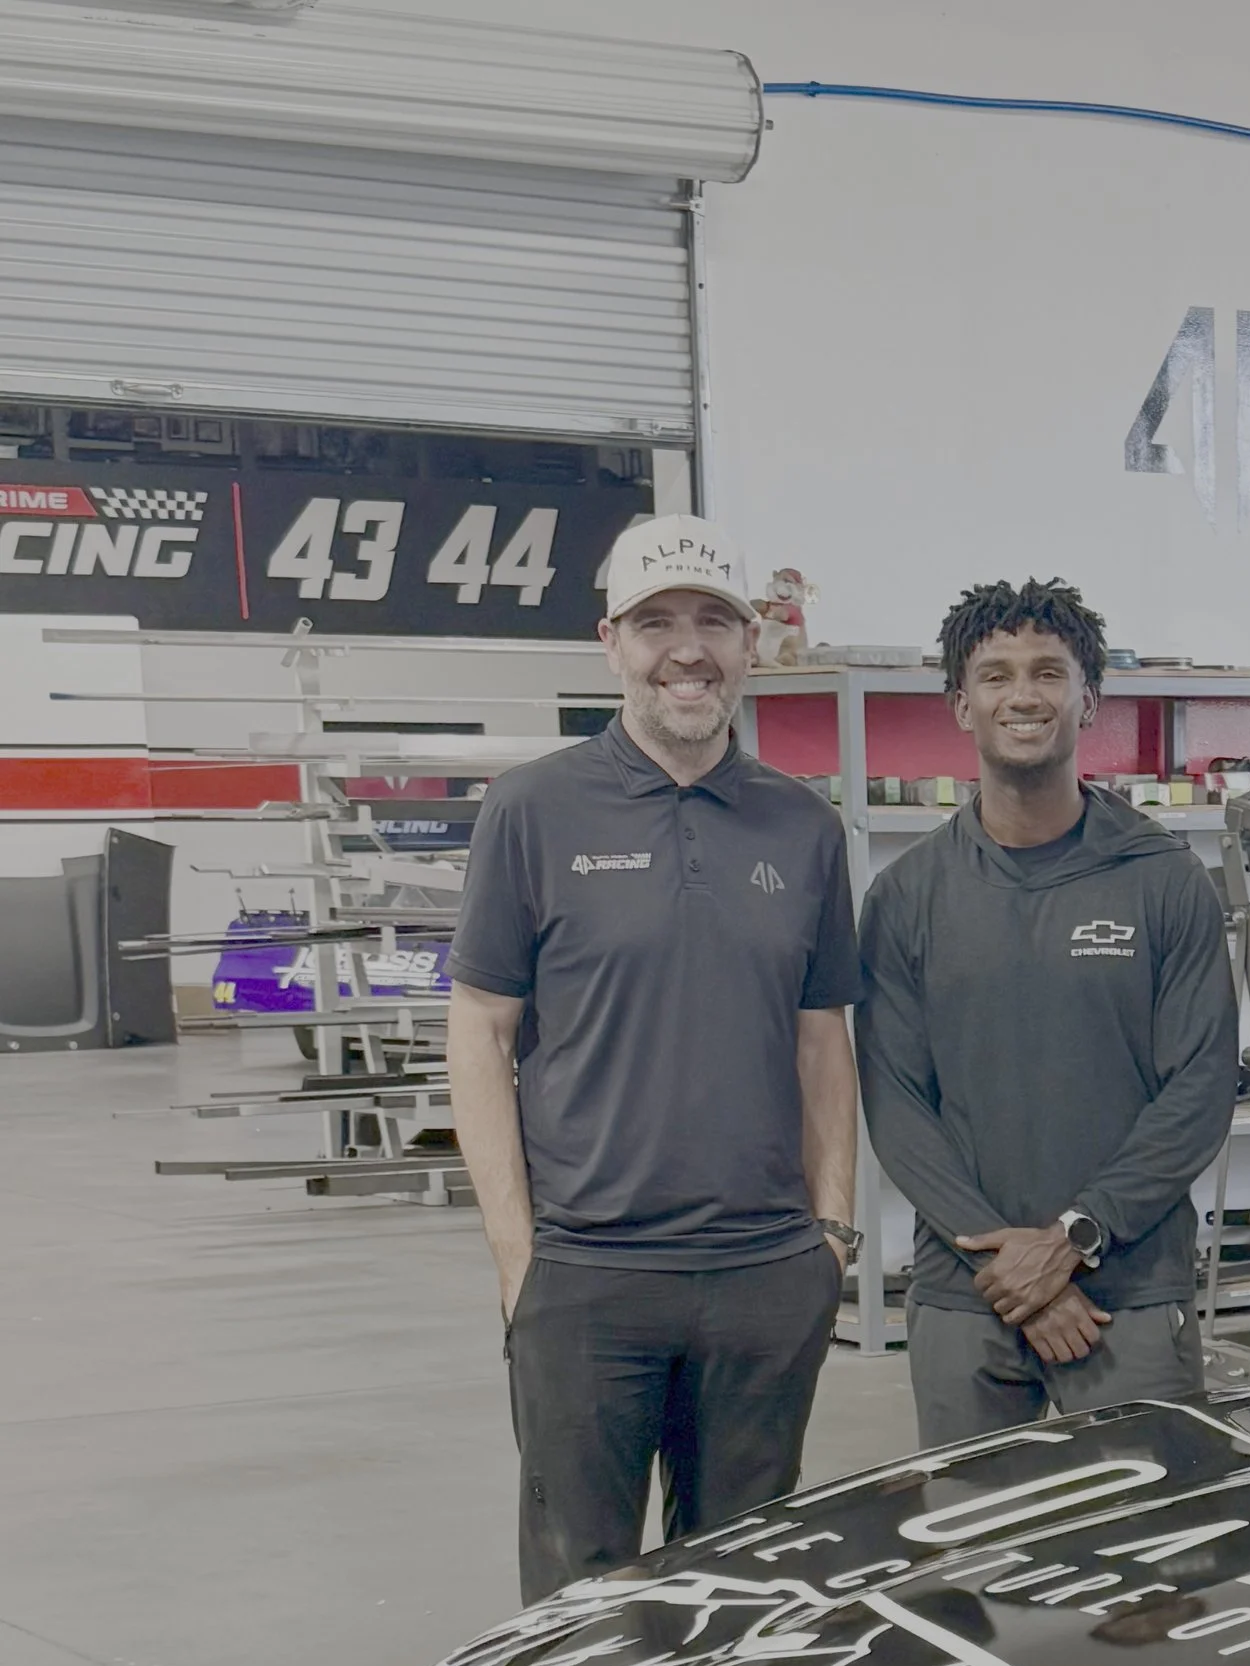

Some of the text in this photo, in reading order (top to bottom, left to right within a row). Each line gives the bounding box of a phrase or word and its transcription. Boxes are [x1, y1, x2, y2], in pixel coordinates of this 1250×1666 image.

[267, 498, 406, 601] 43
[427, 505, 560, 606] 44
[641, 538, 732, 581] ALPHA
[665, 564, 713, 577] PRIME
[1071, 947, 1135, 957] CHEVROLET
[684, 1517, 844, 1562] THE
[826, 1552, 1178, 1616] CTURE
